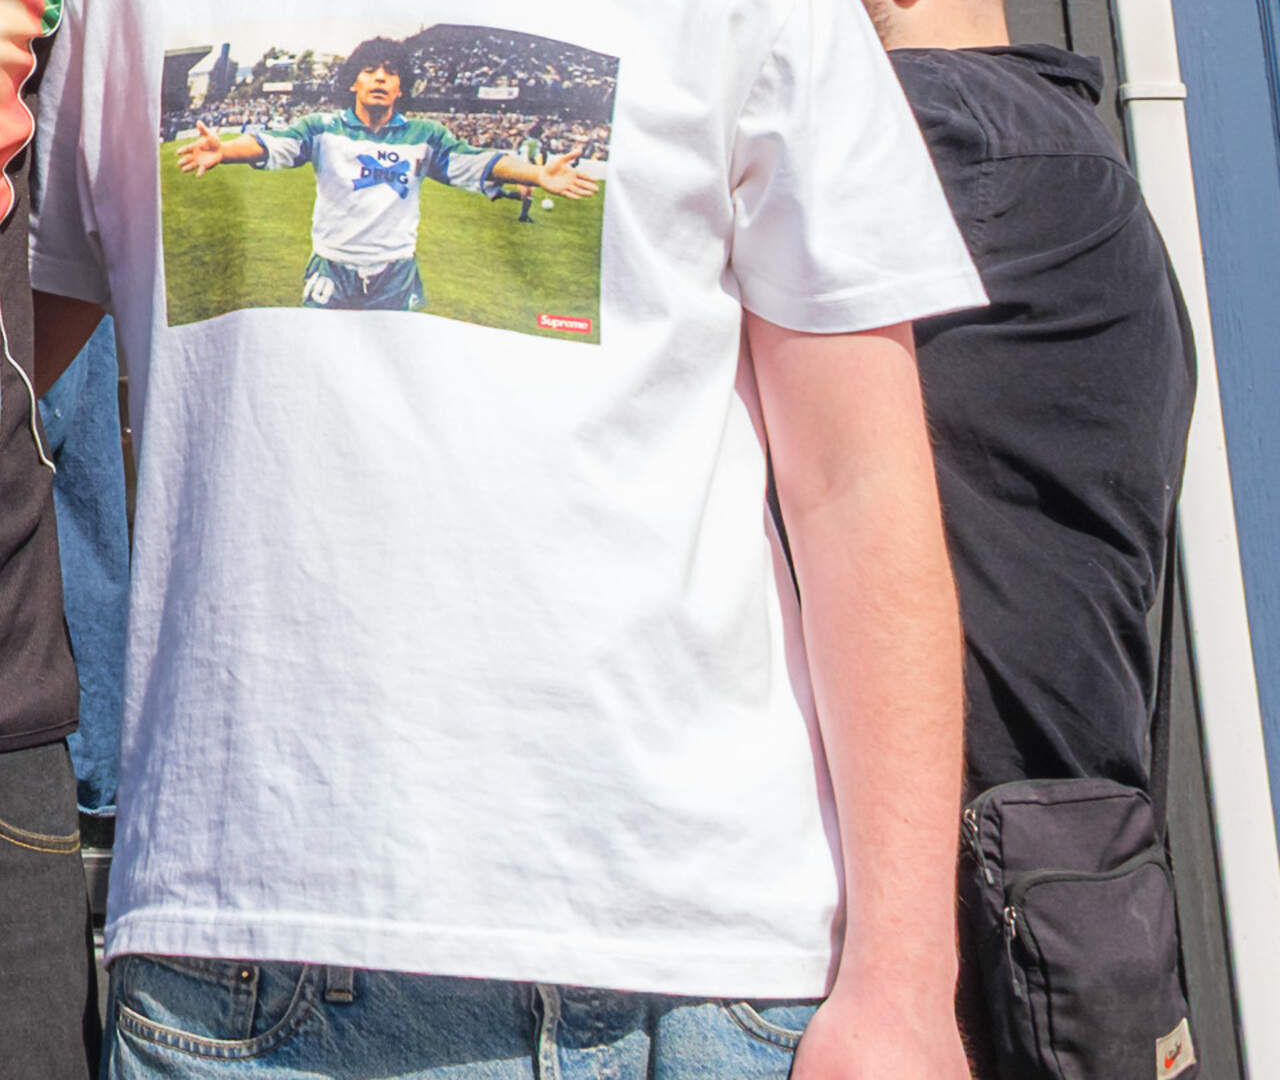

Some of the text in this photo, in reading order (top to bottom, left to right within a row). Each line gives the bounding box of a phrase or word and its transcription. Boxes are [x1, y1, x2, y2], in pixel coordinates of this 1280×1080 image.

[377, 150, 400, 163] NO
[303, 271, 335, 305] 10
[540, 314, 589, 330] Supreme
